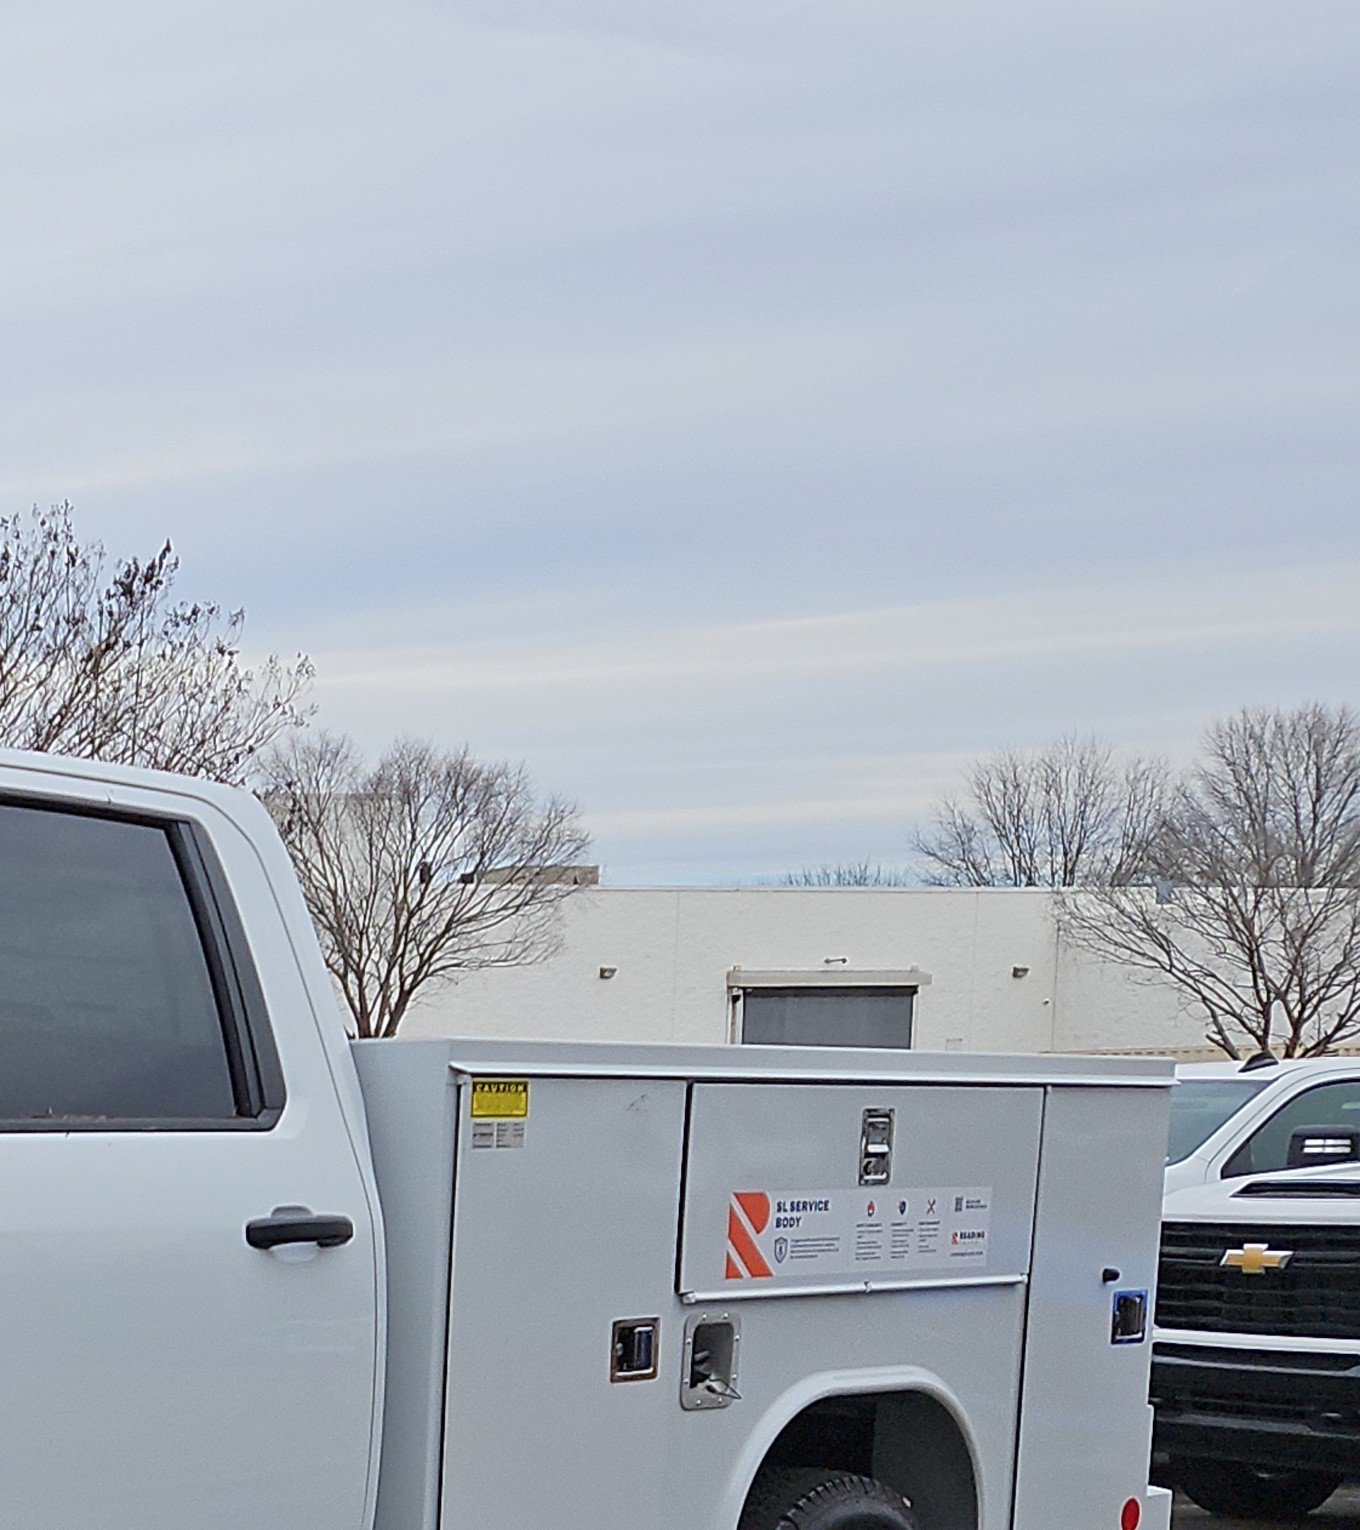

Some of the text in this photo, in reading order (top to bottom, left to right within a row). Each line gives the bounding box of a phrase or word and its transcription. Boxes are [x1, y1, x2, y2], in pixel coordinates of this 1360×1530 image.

[475, 1083, 525, 1093] CAUTION
[776, 1199, 830, 1213] SL SERVICE
[775, 1216, 802, 1229] BODY
